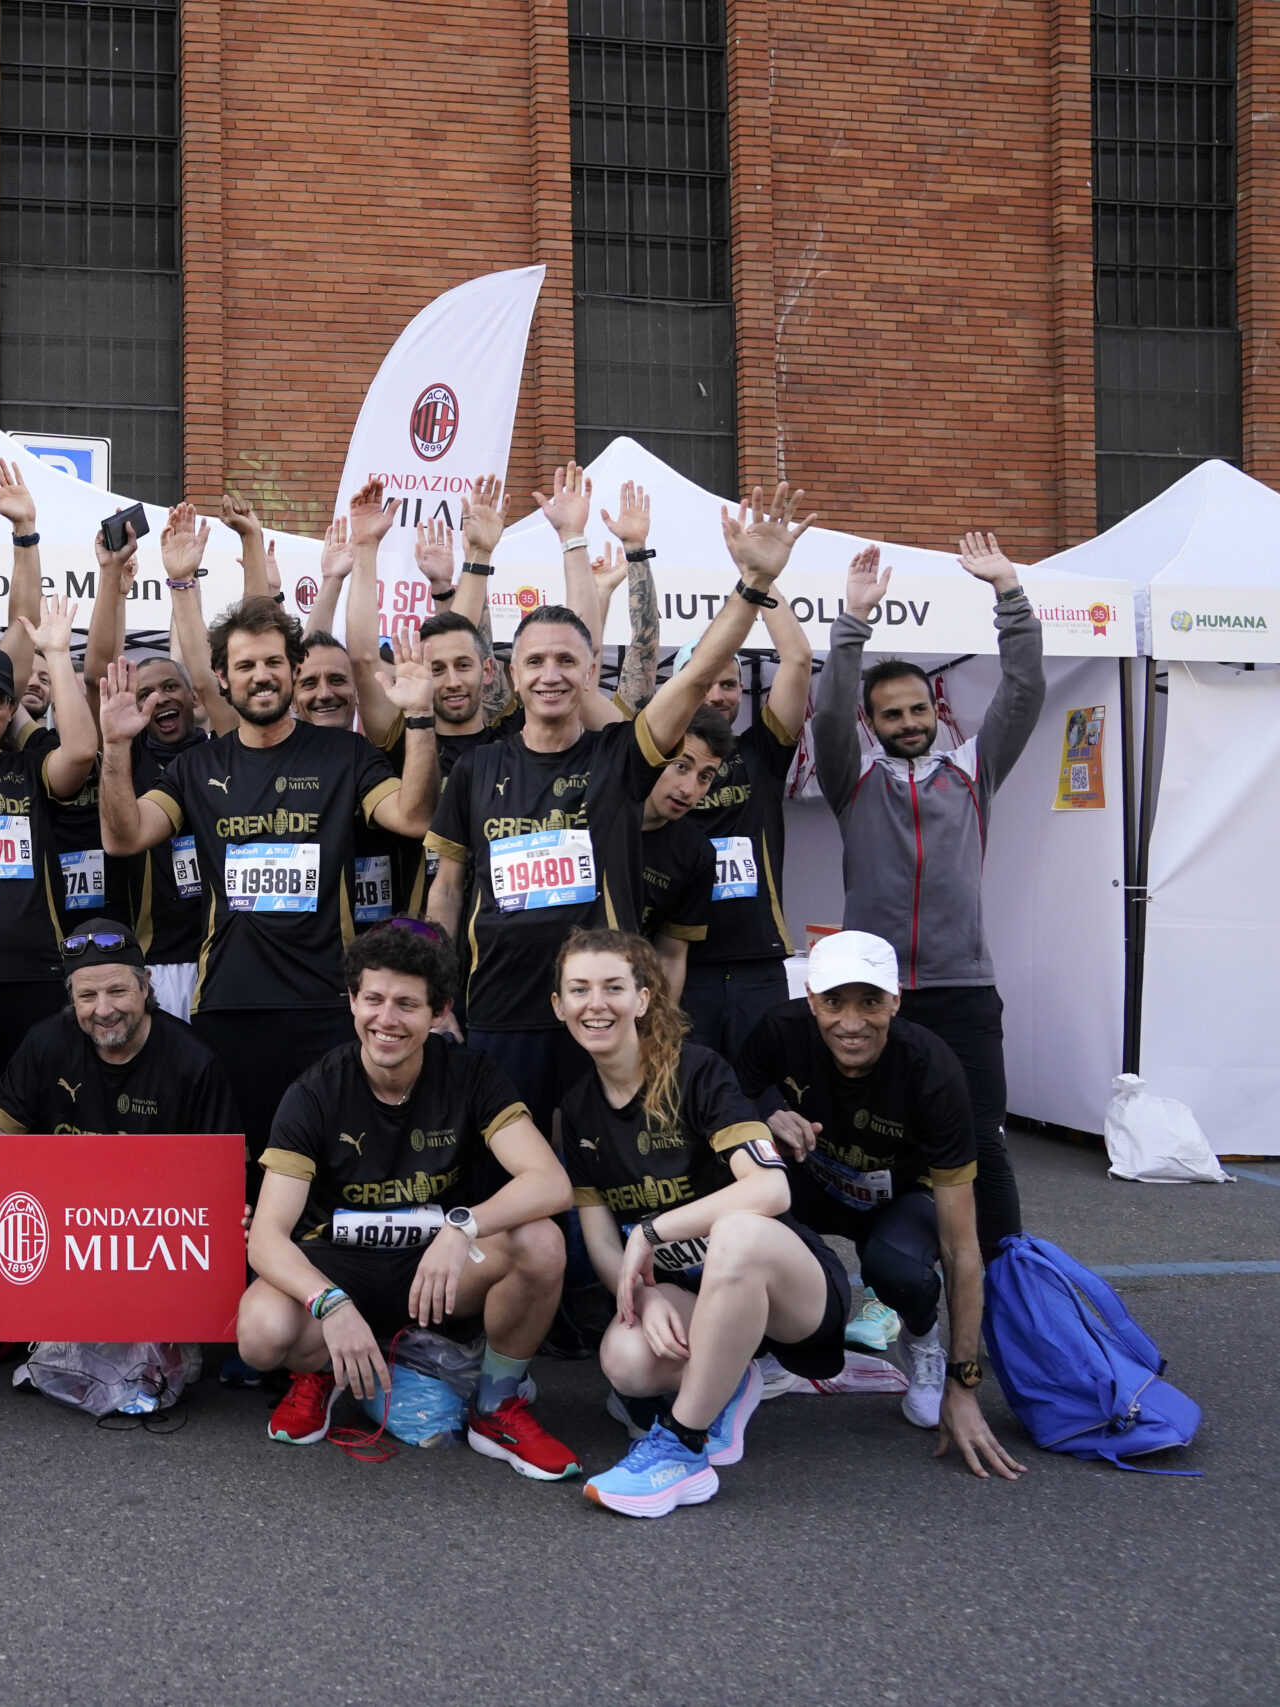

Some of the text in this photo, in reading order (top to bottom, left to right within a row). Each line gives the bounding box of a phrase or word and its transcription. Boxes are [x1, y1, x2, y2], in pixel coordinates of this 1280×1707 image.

[424, 390, 451, 404] ACM
[420, 442, 443, 452] 1899
[368, 473, 485, 493] FONDAZION
[521, 594, 534, 603] 35
[1093, 610, 1105, 619] 35
[1196, 614, 1267, 628] HUMANA
[288, 782, 320, 790] MILAN
[240, 868, 301, 894] 1938B
[507, 857, 575, 892] 1948D
[131, 1103, 158, 1115] MILAN
[870, 1120, 904, 1139] MILAN
[426, 1135, 457, 1148] MILAN
[7, 1199, 36, 1216] ACM
[64, 1207, 210, 1227] FONDAZIONE
[354, 1225, 423, 1248] 1947B
[64, 1235, 210, 1271] MILAN
[6, 1262, 34, 1273] 1899
[649, 1464, 687, 1488] HOKA
